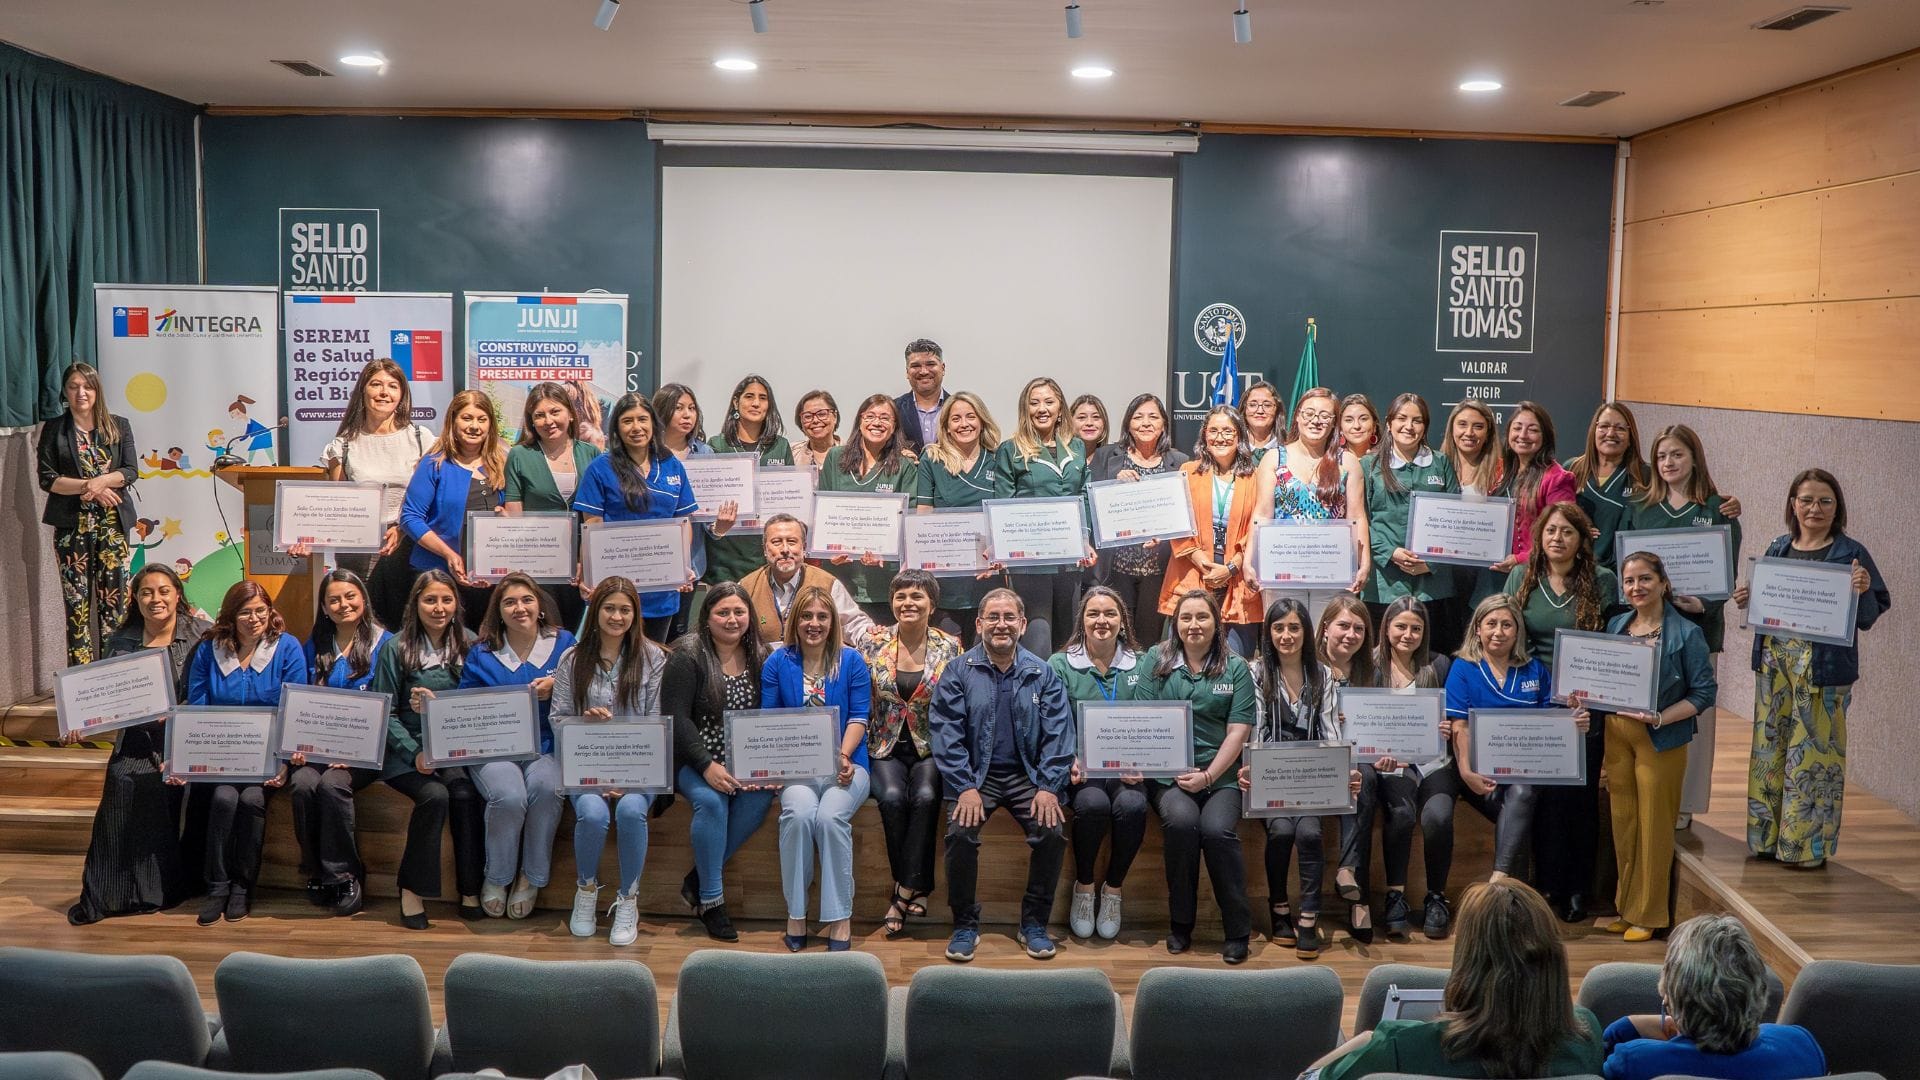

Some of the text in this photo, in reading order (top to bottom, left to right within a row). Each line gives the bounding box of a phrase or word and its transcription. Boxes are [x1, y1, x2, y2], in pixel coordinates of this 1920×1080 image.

[291, 222, 368, 254] SELLO
[1451, 245, 1525, 276] SELLO
[292, 254, 367, 285] SANTO
[1450, 276, 1524, 307] SANTO
[175, 316, 262, 332] INTEGRA
[517, 308, 577, 328] JUNJI
[1199, 308, 1220, 331] SANTO
[1449, 304, 1522, 339] TOMÁS
[294, 330, 370, 343] SEREMI
[294, 348, 374, 362] de Salud
[480, 343, 576, 353] CONSTRUYENDO
[480, 355, 588, 367] DESDE LA NIÑEZ EL
[1461, 361, 1507, 374] VALORAR
[294, 367, 360, 385] Región
[480, 370, 592, 379] PRESENTE DE CHILE
[295, 387, 323, 400] del
[1174, 371, 1263, 408] UT
[1466, 386, 1500, 399] EXIGIR
